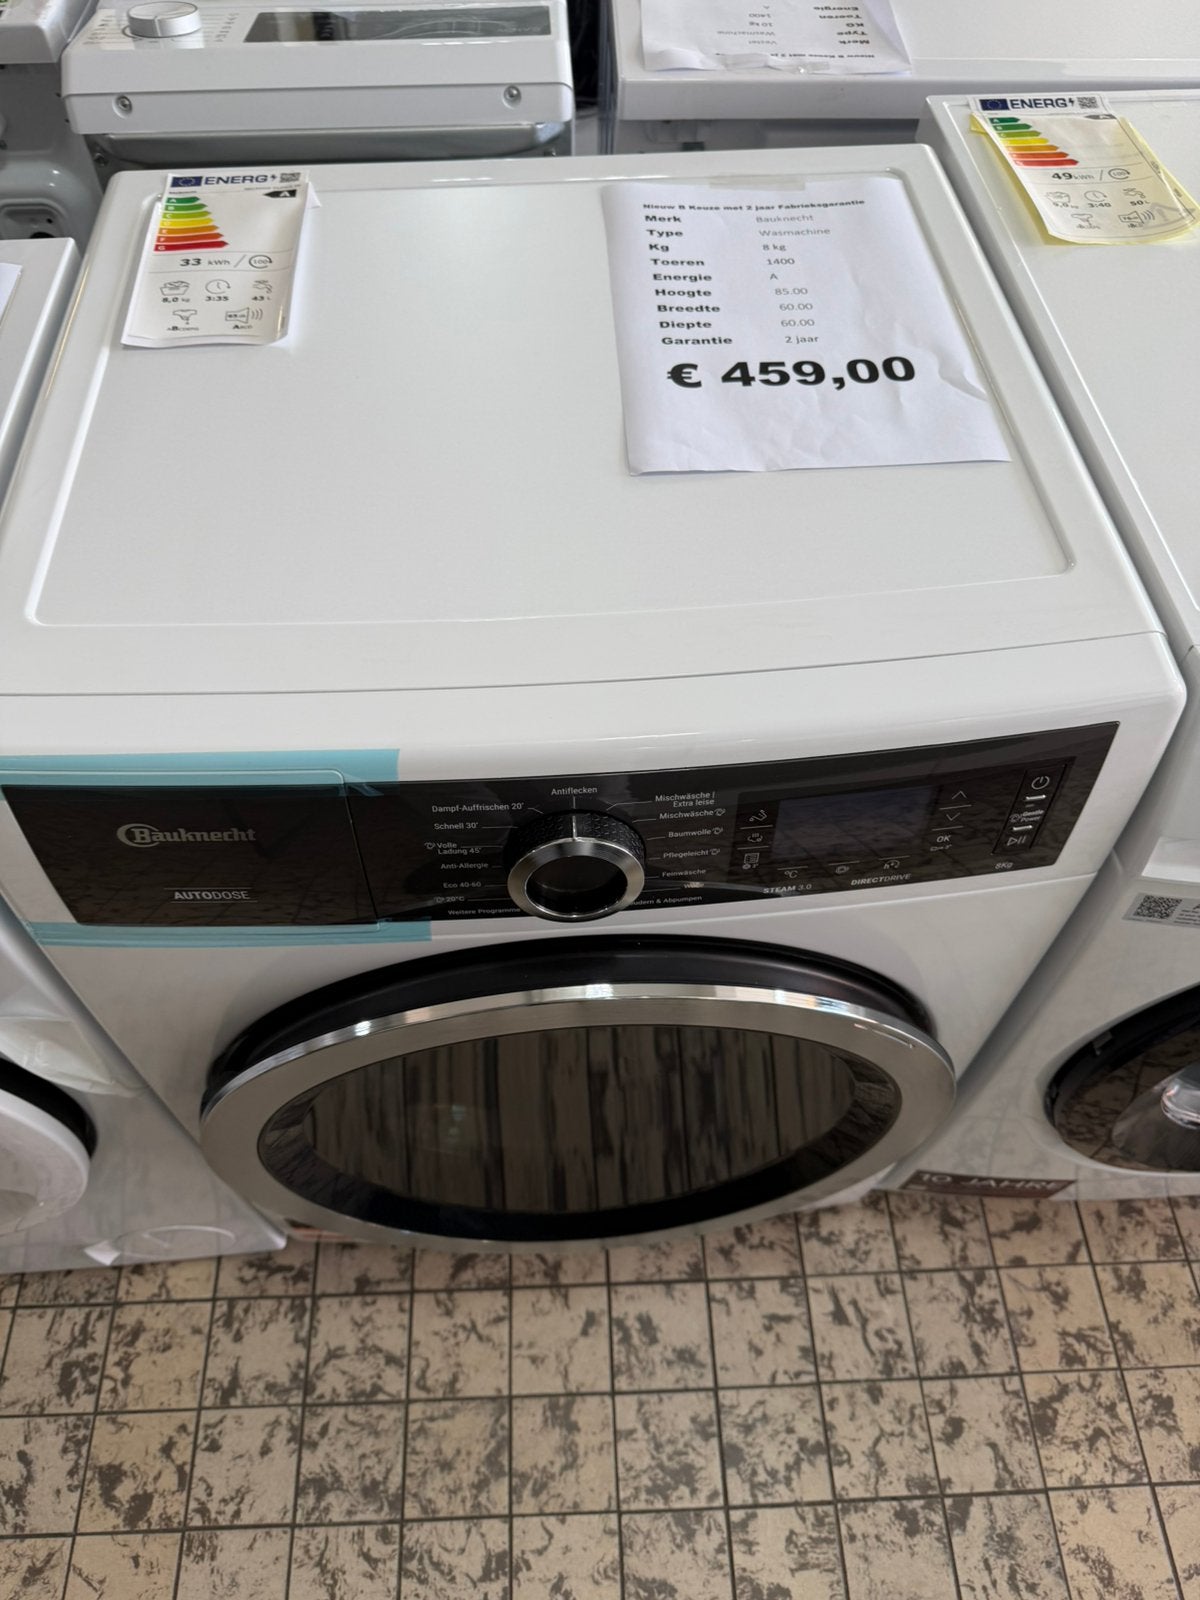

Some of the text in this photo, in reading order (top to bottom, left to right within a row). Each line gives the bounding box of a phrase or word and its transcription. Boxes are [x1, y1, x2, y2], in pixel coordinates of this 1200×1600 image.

[1010, 97, 1068, 110] ENERG
[204, 173, 268, 186] ENERG
[1051, 172, 1073, 181] 49
[755, 204, 775, 212] jaar
[644, 214, 682, 223] Merk
[755, 214, 814, 223] Bauknecht
[645, 228, 684, 238] Type
[758, 227, 831, 237] Wasmachine
[648, 243, 670, 252] Kg
[772, 243, 787, 252] kg
[179, 257, 202, 267] 33
[650, 258, 705, 266] Toeren
[766, 257, 796, 266] 1400
[652, 272, 713, 283] Energie
[769, 272, 779, 281] A
[654, 287, 712, 298] Hoogte
[774, 286, 809, 297] 85.00
[656, 303, 721, 314] Breedte
[778, 301, 814, 312] 60.00
[658, 319, 713, 331] Diepte
[780, 318, 816, 328] 60.00
[661, 335, 733, 346] Garantie
[784, 334, 820, 346] 2 jaar
[666, 355, 917, 392] € 459,00
[550, 786, 598, 796] Antiflecken
[654, 791, 711, 803] Mischwäsche
[431, 803, 510, 813] Dampf-Auffrischen
[672, 798, 715, 808] Extra leise
[659, 809, 714, 820] Mischwäsche
[1022, 809, 1045, 817] Gentle
[433, 822, 464, 830] Schnell
[120, 826, 256, 844] Bauknecht
[668, 828, 712, 838] Baumwolle
[936, 834, 951, 845] OK
[437, 848, 468, 856] Ladung
[663, 849, 709, 859] Pflegeleicht
[440, 861, 489, 870] Anti-Allergie
[661, 867, 707, 878] Feinwäsche
[850, 873, 912, 886] DIRECTDRIVE
[763, 885, 796, 894] STEAM
[173, 890, 251, 900] AUTODOSE
[447, 908, 477, 916] Weitere
